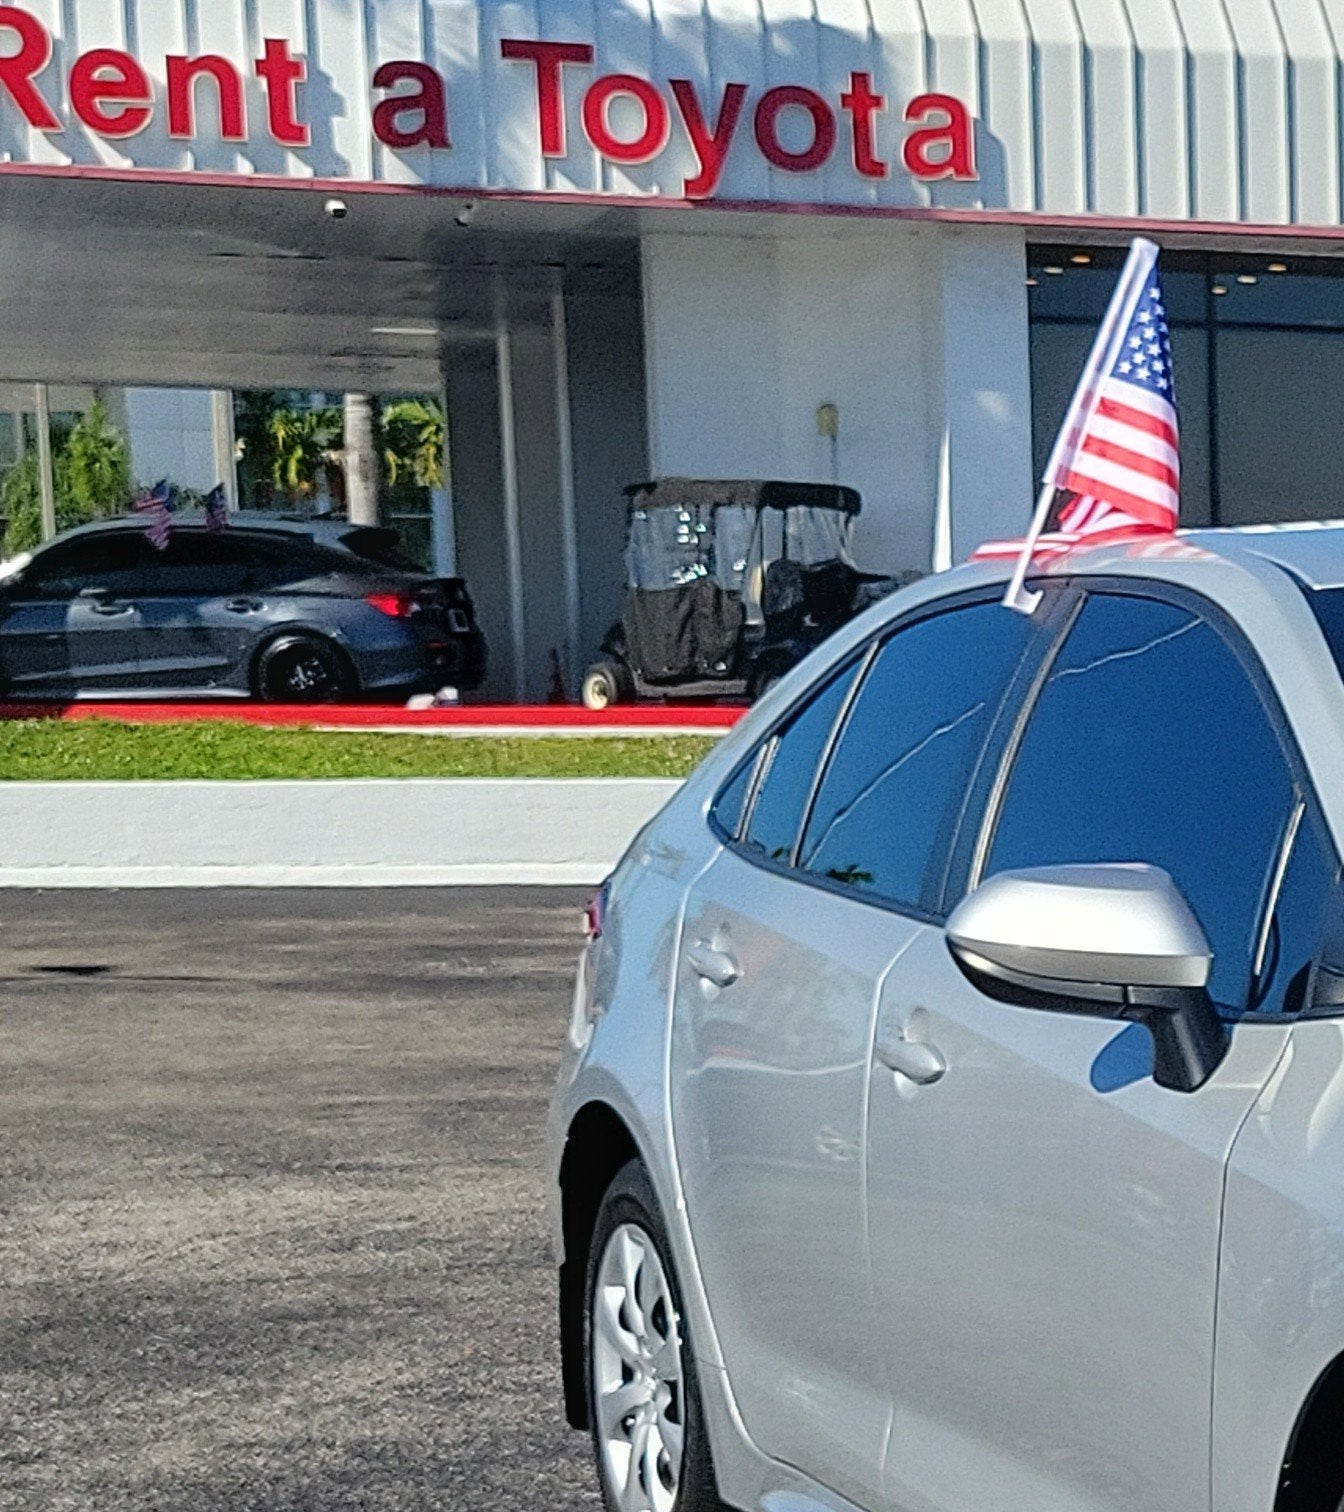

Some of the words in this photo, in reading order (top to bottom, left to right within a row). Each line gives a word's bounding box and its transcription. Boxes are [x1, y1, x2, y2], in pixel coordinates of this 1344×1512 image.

[0, 5, 311, 147] Rent
[371, 59, 452, 150] a
[500, 38, 979, 198] Toyota
